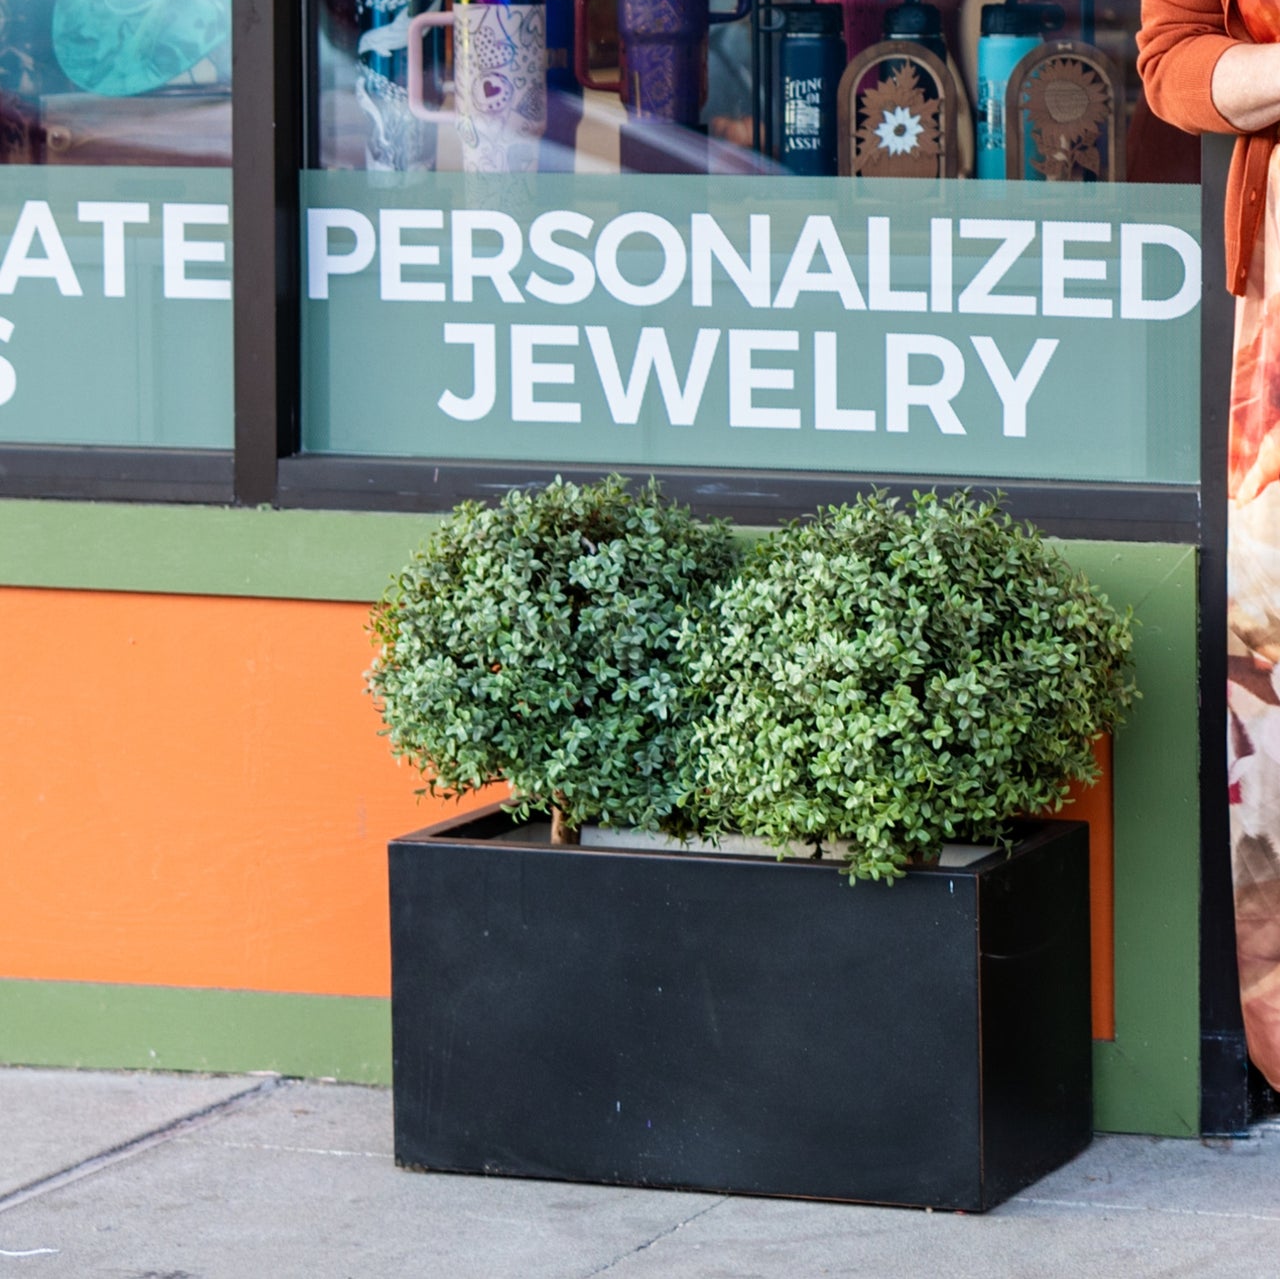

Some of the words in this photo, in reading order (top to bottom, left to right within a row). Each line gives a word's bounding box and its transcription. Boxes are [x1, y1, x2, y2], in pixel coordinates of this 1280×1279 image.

[0, 200, 233, 300] ATE
[307, 208, 1202, 320] PERSONALIZED
[437, 322, 1060, 437] JEWELRY
